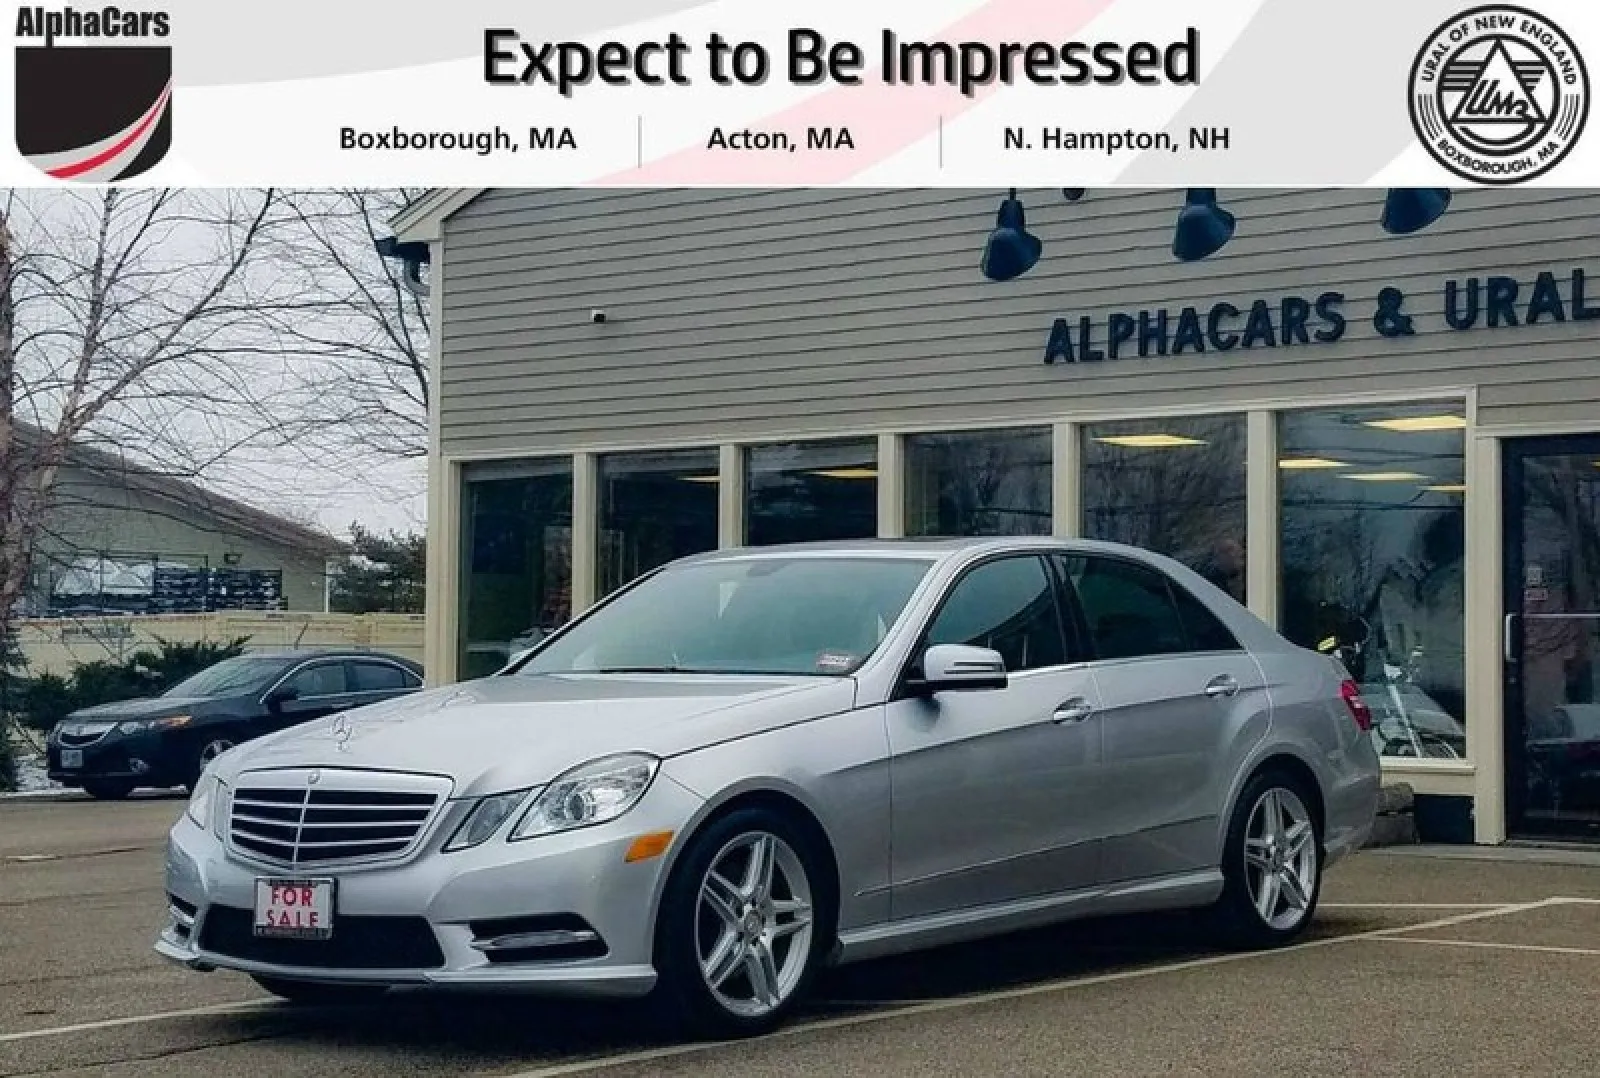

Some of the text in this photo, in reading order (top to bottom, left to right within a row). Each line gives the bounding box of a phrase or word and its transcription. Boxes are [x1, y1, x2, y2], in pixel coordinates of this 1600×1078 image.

[1044, 268, 1600, 365] ALPHACARS & URAL
[271, 885, 313, 906] FOR
[267, 910, 319, 927] SALE
